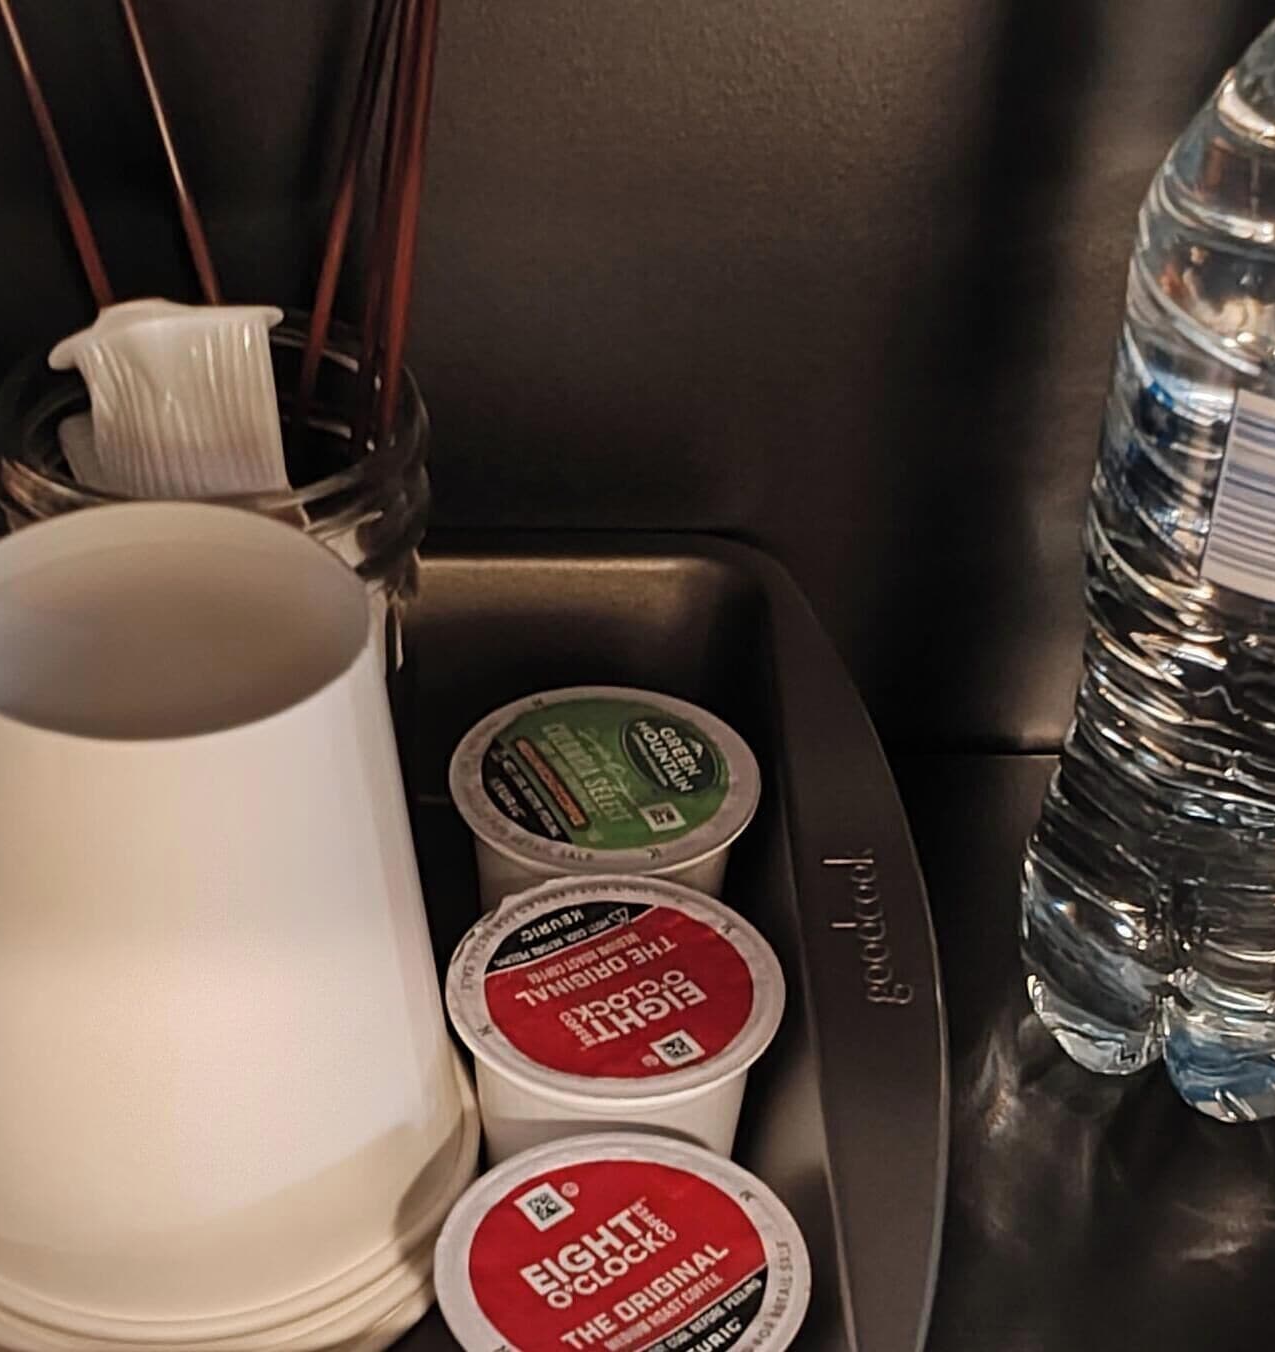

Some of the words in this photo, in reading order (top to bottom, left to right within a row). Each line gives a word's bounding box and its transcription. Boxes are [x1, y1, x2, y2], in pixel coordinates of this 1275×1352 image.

[635, 720, 694, 793] MOUNTAIN
[660, 726, 703, 776] GREEN
[520, 908, 585, 943] KEURIG
[626, 935, 677, 965] THE
[823, 850, 913, 1004] goodcook
[515, 955, 628, 1007] ORIGINAL
[571, 969, 685, 1023] O'CLOCK
[590, 980, 708, 1042] EIGHT
[519, 1208, 643, 1296] EIGHT
[547, 1231, 667, 1309] O'CLOCK
[561, 1313, 618, 1349] THE
[613, 1244, 730, 1322] ORIGINAL
[647, 1295, 687, 1328] ROAST
[683, 1271, 724, 1305] COFFEE
